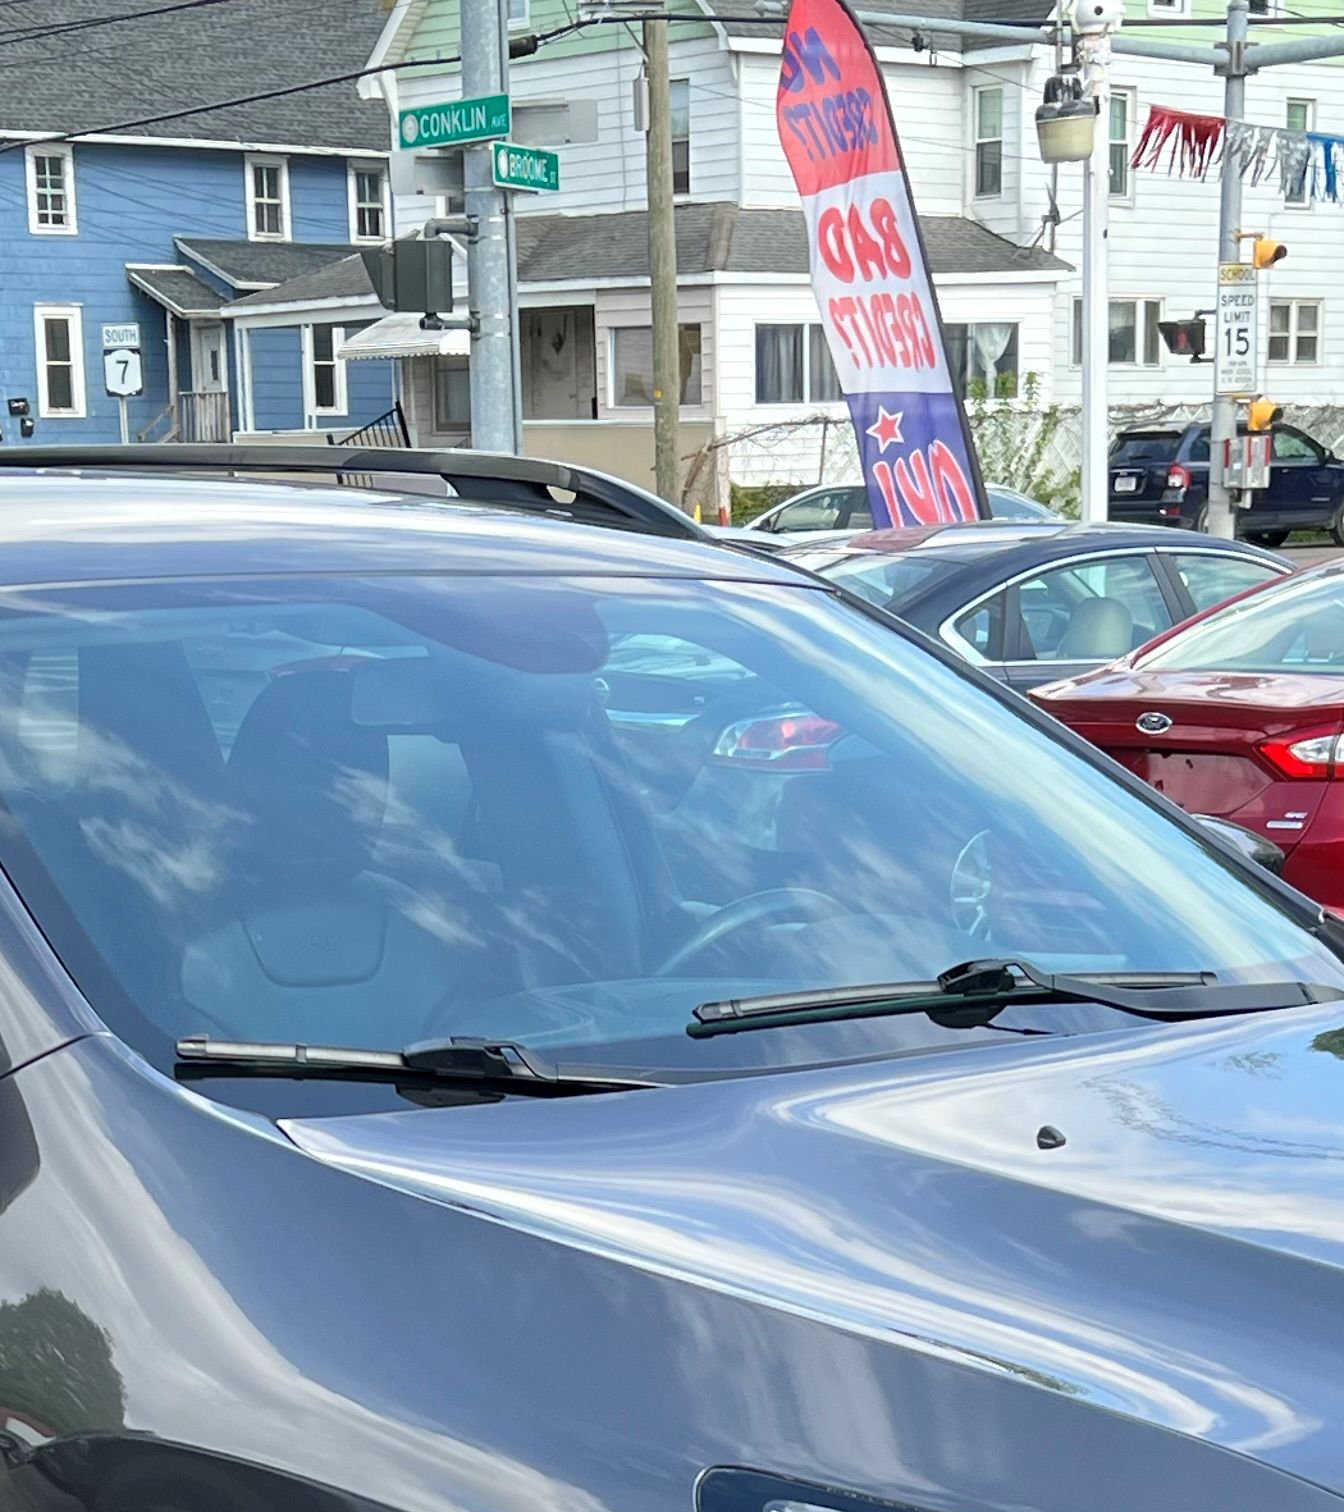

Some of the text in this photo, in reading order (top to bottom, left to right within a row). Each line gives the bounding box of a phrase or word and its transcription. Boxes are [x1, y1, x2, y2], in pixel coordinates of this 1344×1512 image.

[419, 105, 506, 138] CONKLIN AVE
[509, 153, 548, 182] BROOME
[1220, 268, 1255, 281] SCHOOL
[1221, 294, 1254, 307] SPEED
[1224, 311, 1251, 323] LIMIT
[104, 329, 137, 343] SOUTH
[1225, 327, 1250, 357] 15
[116, 360, 129, 385] 7
